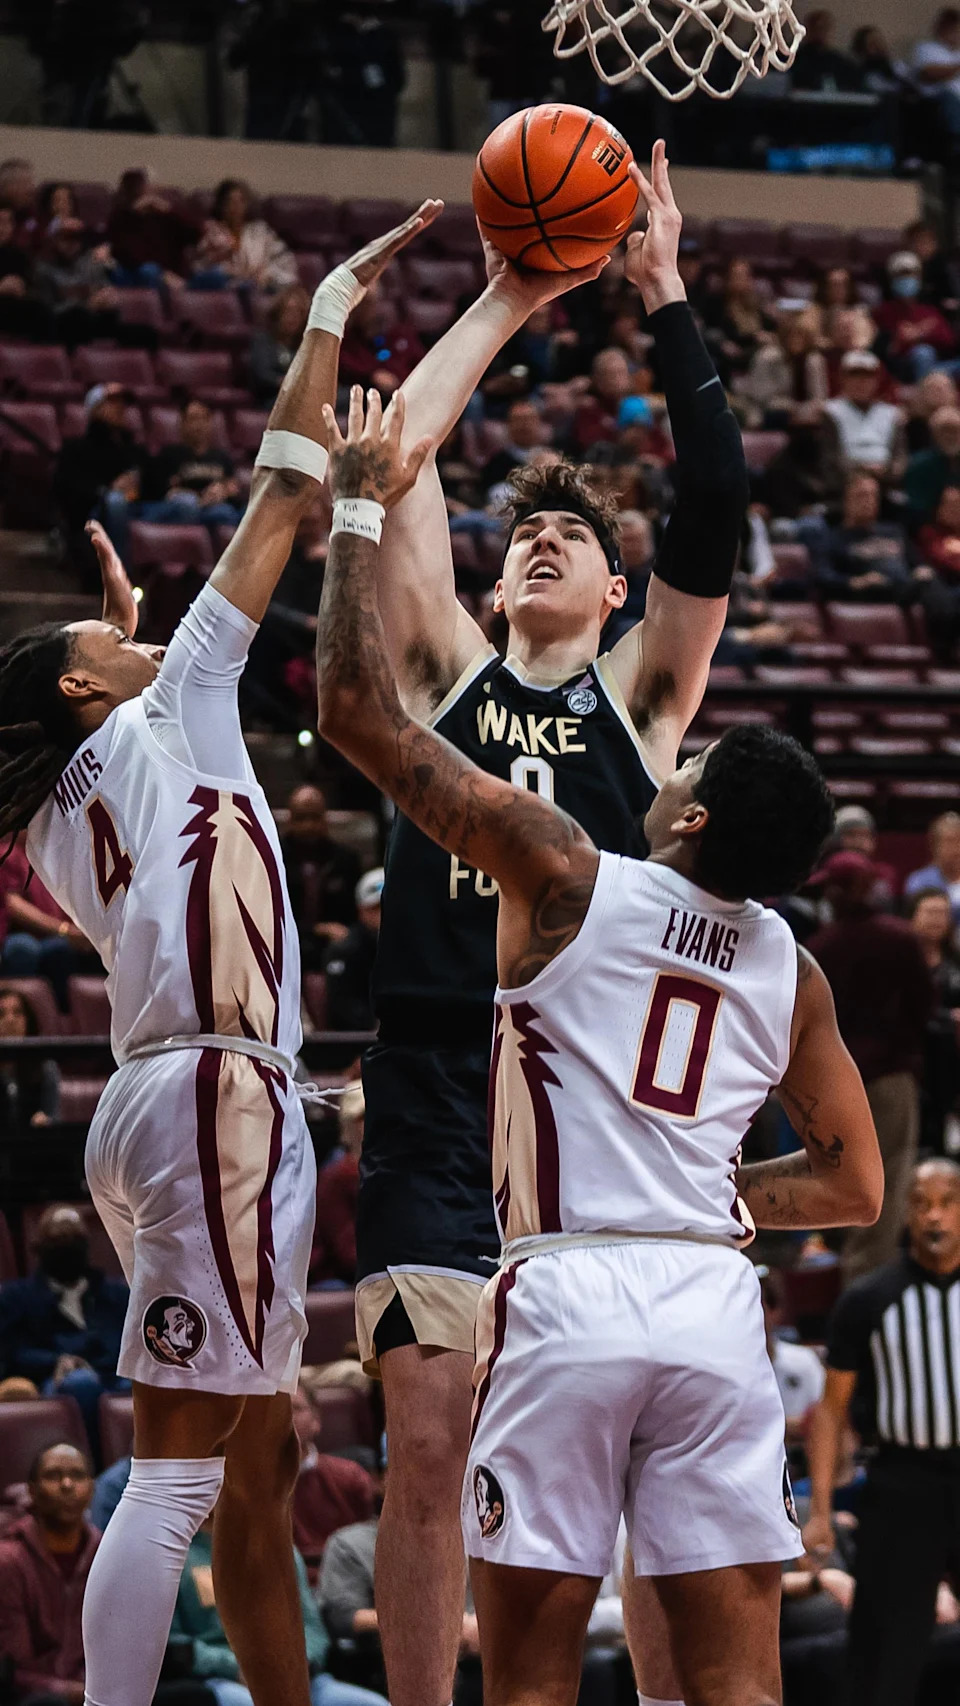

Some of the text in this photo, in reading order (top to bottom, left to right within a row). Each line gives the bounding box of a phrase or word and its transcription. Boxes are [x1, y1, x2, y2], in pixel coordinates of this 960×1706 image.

[476, 700, 587, 755] WAKE
[53, 748, 103, 818] MILLS
[84, 792, 136, 912] 4
[660, 906, 740, 973] EVANS
[629, 970, 725, 1122] 0
